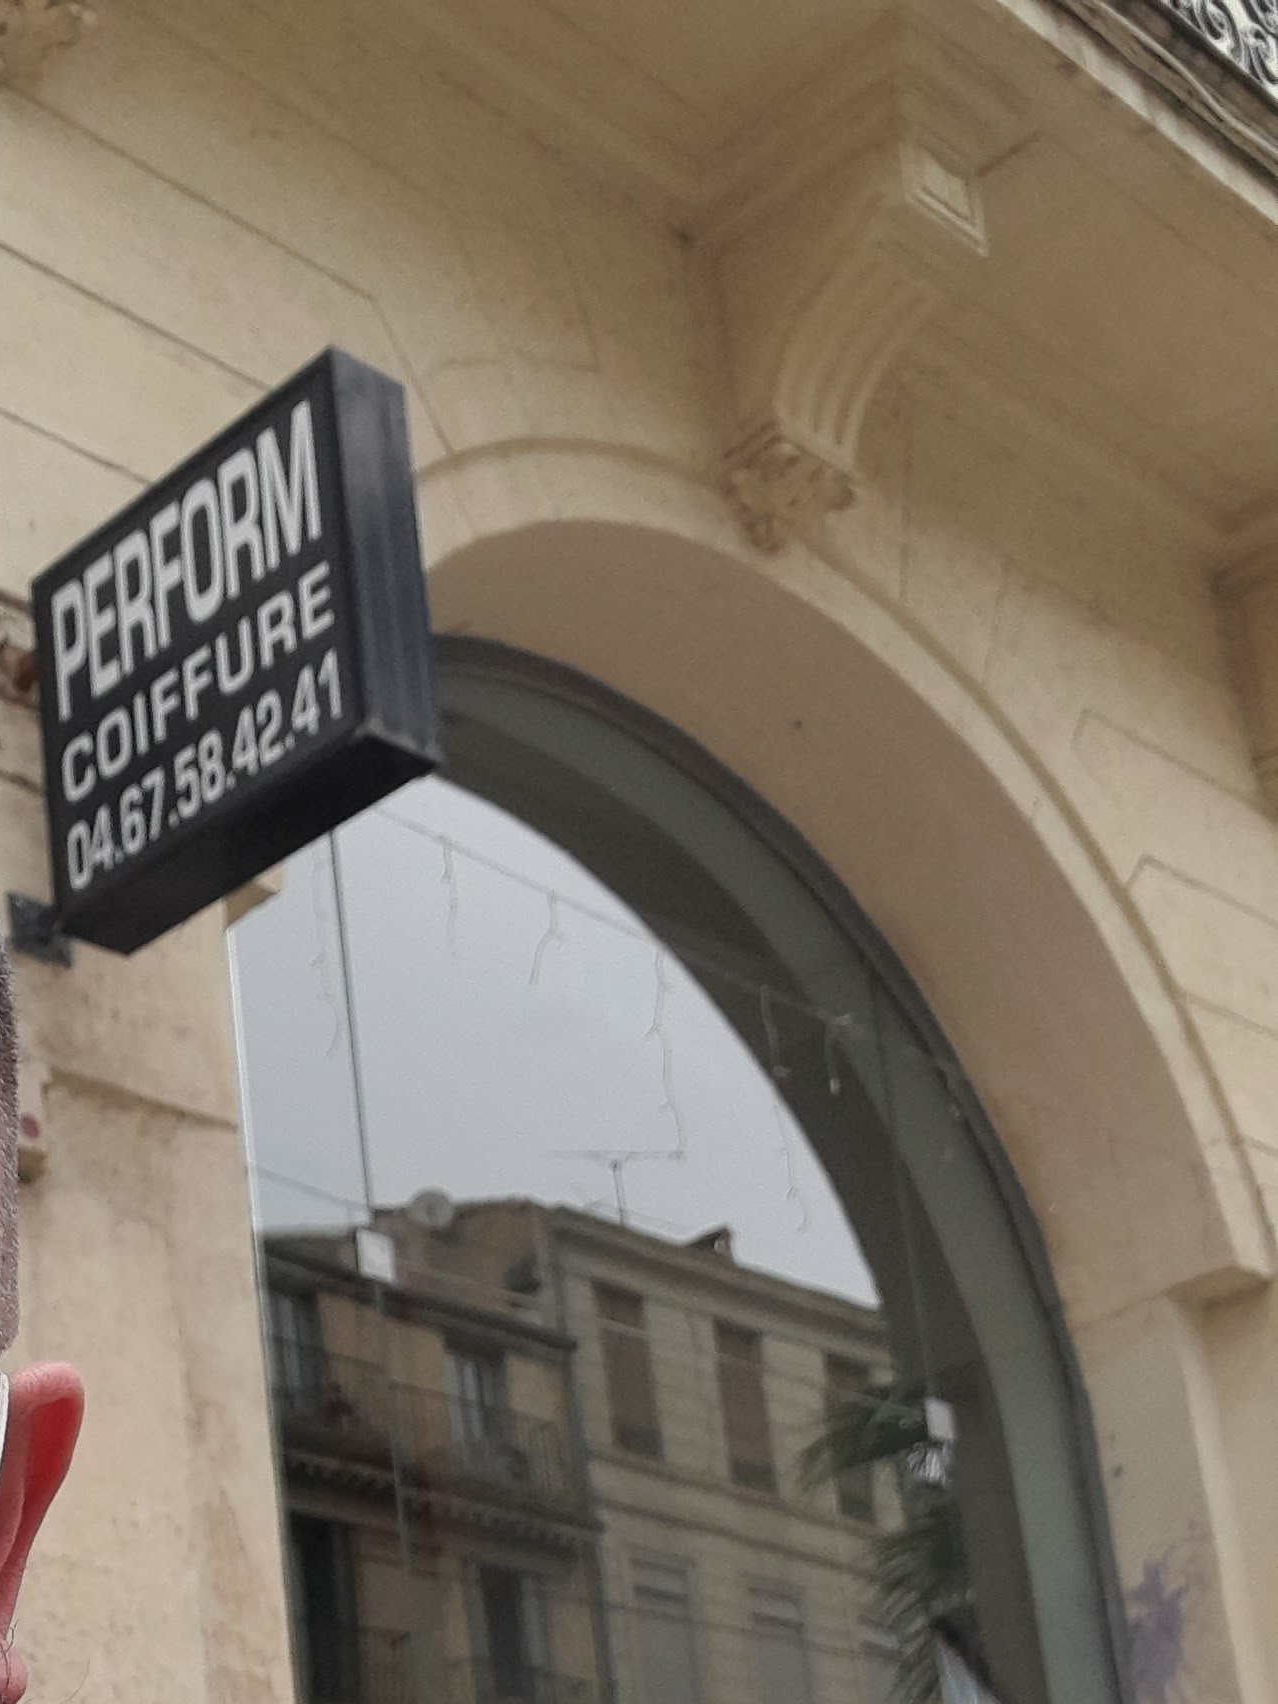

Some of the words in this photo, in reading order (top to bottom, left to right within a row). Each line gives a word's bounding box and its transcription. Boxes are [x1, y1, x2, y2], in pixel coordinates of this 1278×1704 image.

[52, 400, 322, 721] PERFORM
[61, 561, 335, 803] COIFFURE
[66, 650, 343, 890] 04.67.58.42.41
